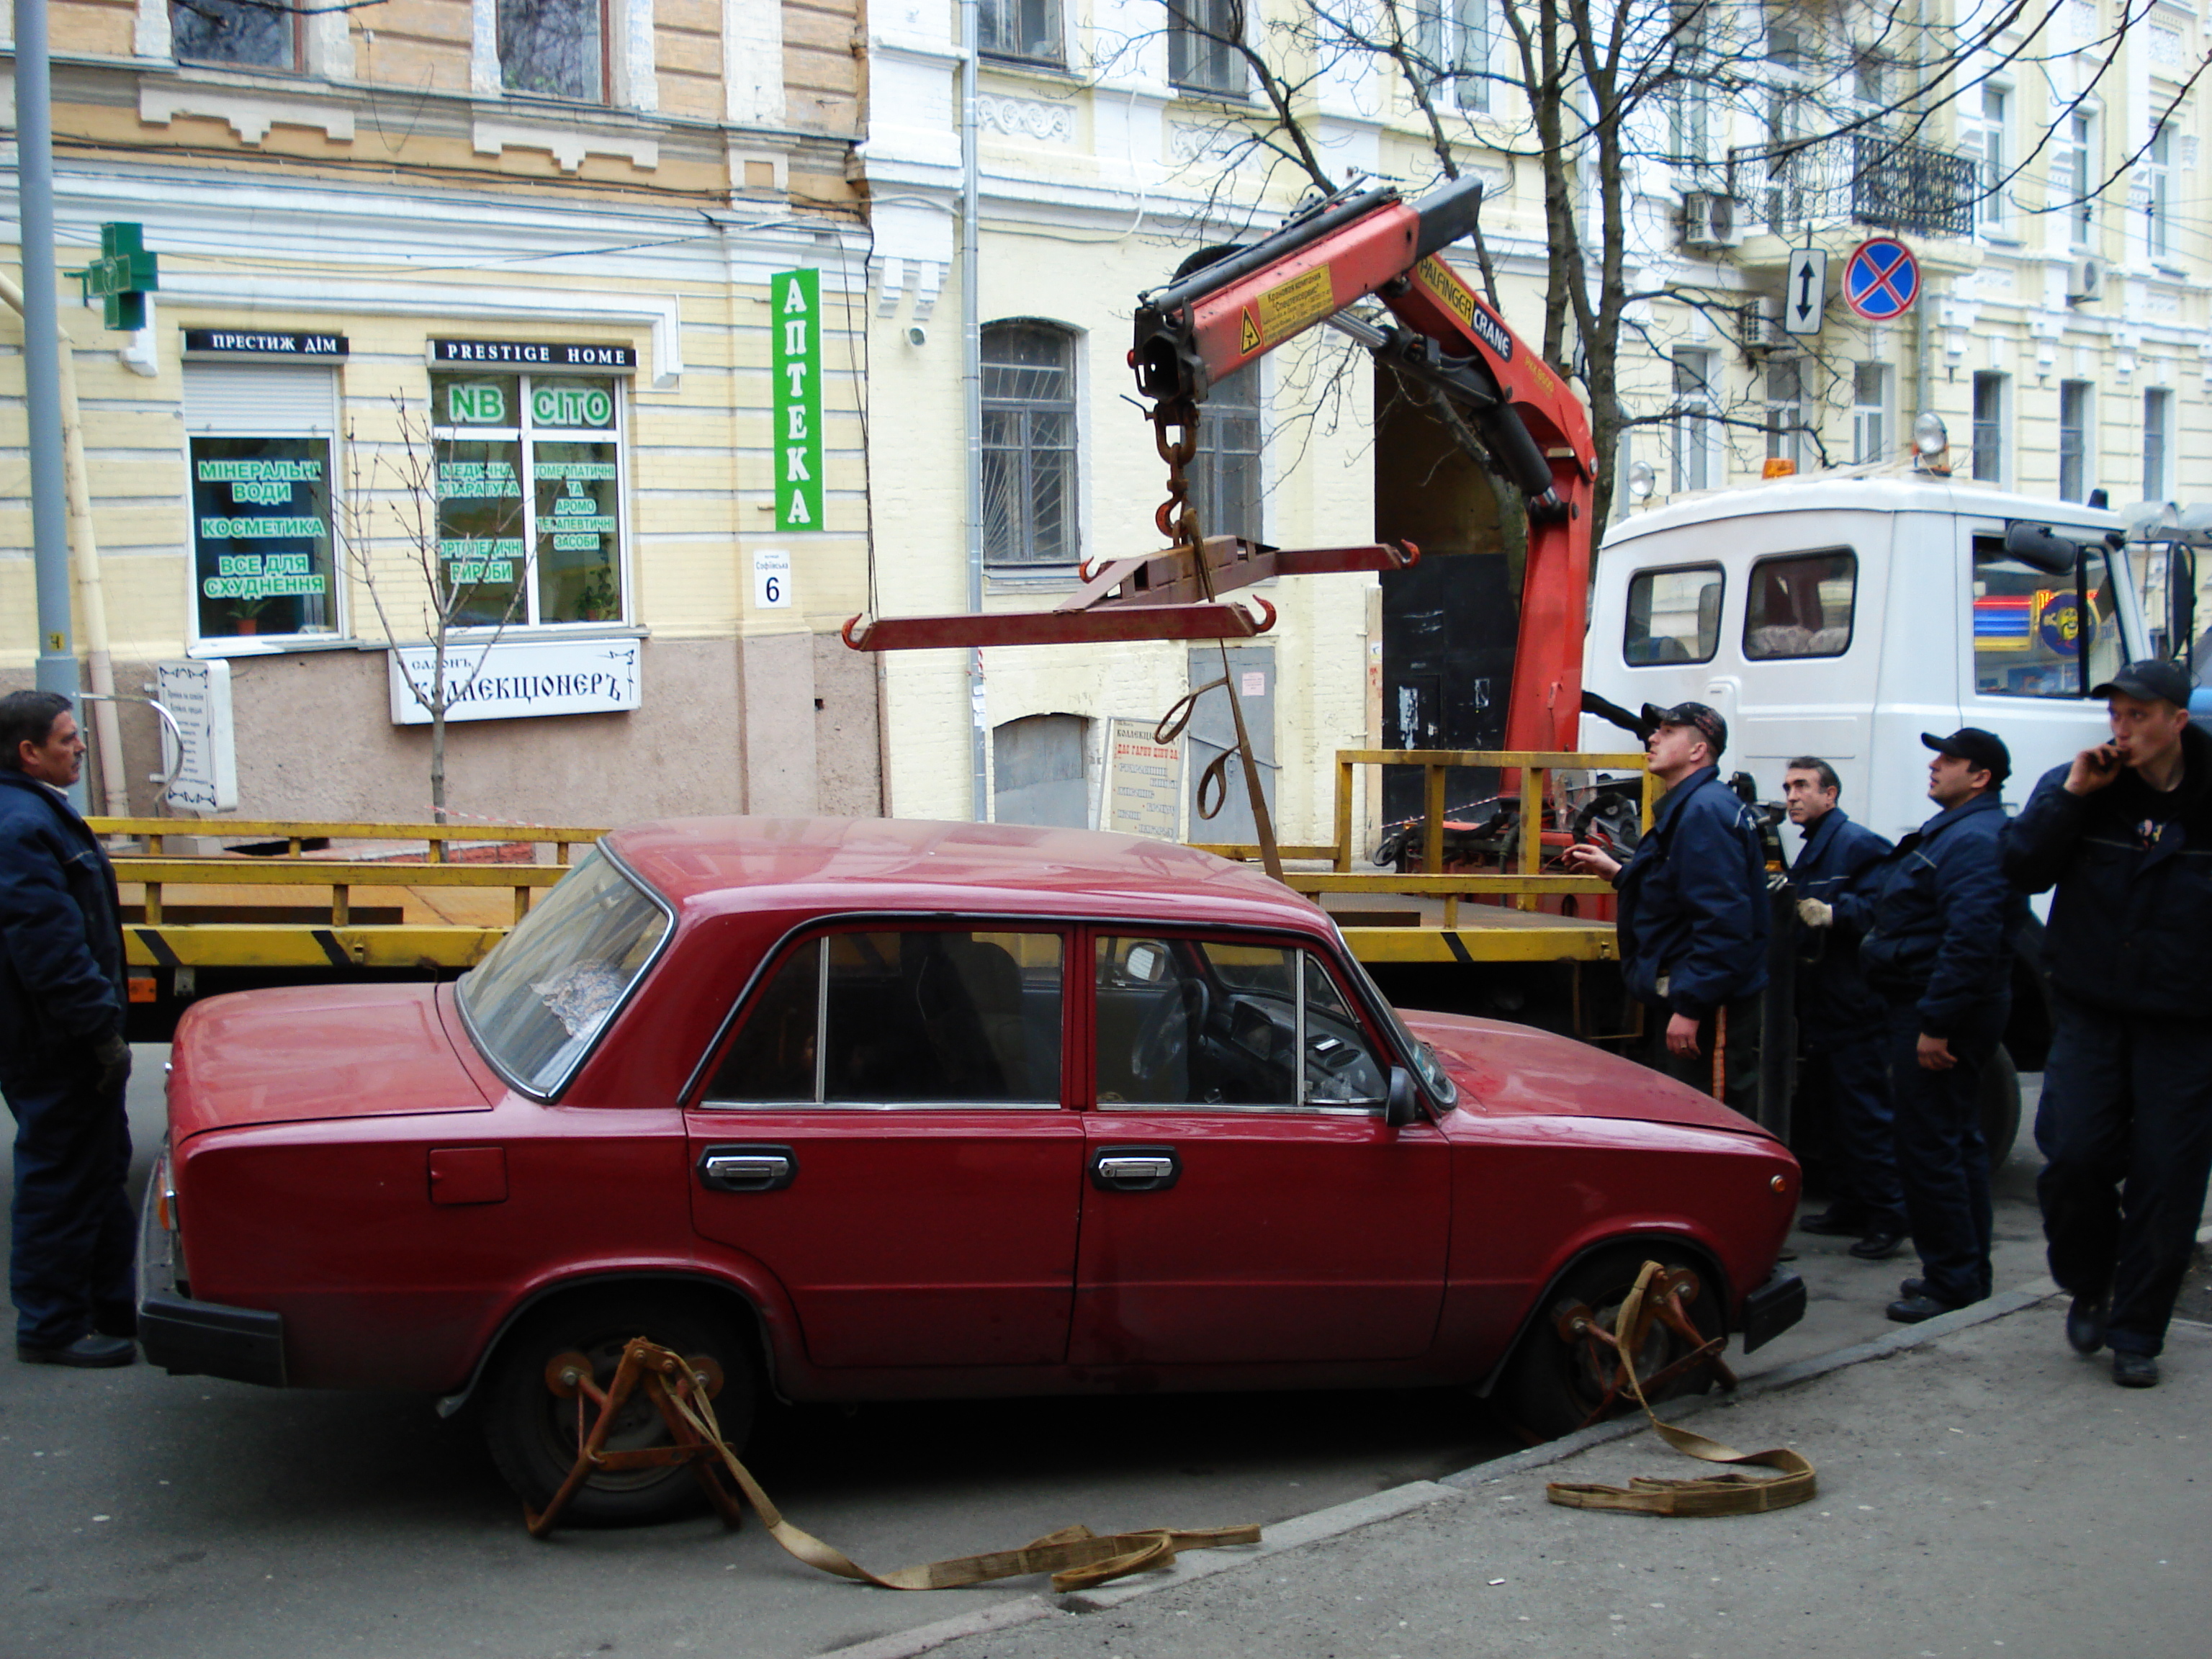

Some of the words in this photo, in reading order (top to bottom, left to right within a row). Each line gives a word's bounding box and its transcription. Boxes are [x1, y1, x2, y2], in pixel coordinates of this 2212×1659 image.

[1420, 258, 1472, 320] PALFINGER
[1473, 308, 1510, 357] CRANE
[212, 333, 297, 352] ПРЕСТИЖ
[305, 335, 338, 354] ДІМ
[447, 343, 550, 361] PRESTIGE
[567, 348, 626, 364] HOME
[450, 387, 503, 421] NB
[533, 388, 610, 423] CITO
[783, 278, 811, 523] АПТЕКА
[233, 483, 290, 503] ВОДИ
[567, 482, 583, 496] ТА
[555, 500, 595, 513] АРОМО
[202, 519, 325, 536] КОСМЕТИКА
[554, 535, 598, 549] ЗАСОБИ
[220, 557, 261, 574] ВСЕ
[265, 555, 307, 575] ДЛЯ
[204, 577, 324, 598] СХУДНЕННЯ
[766, 577, 779, 602] 6
